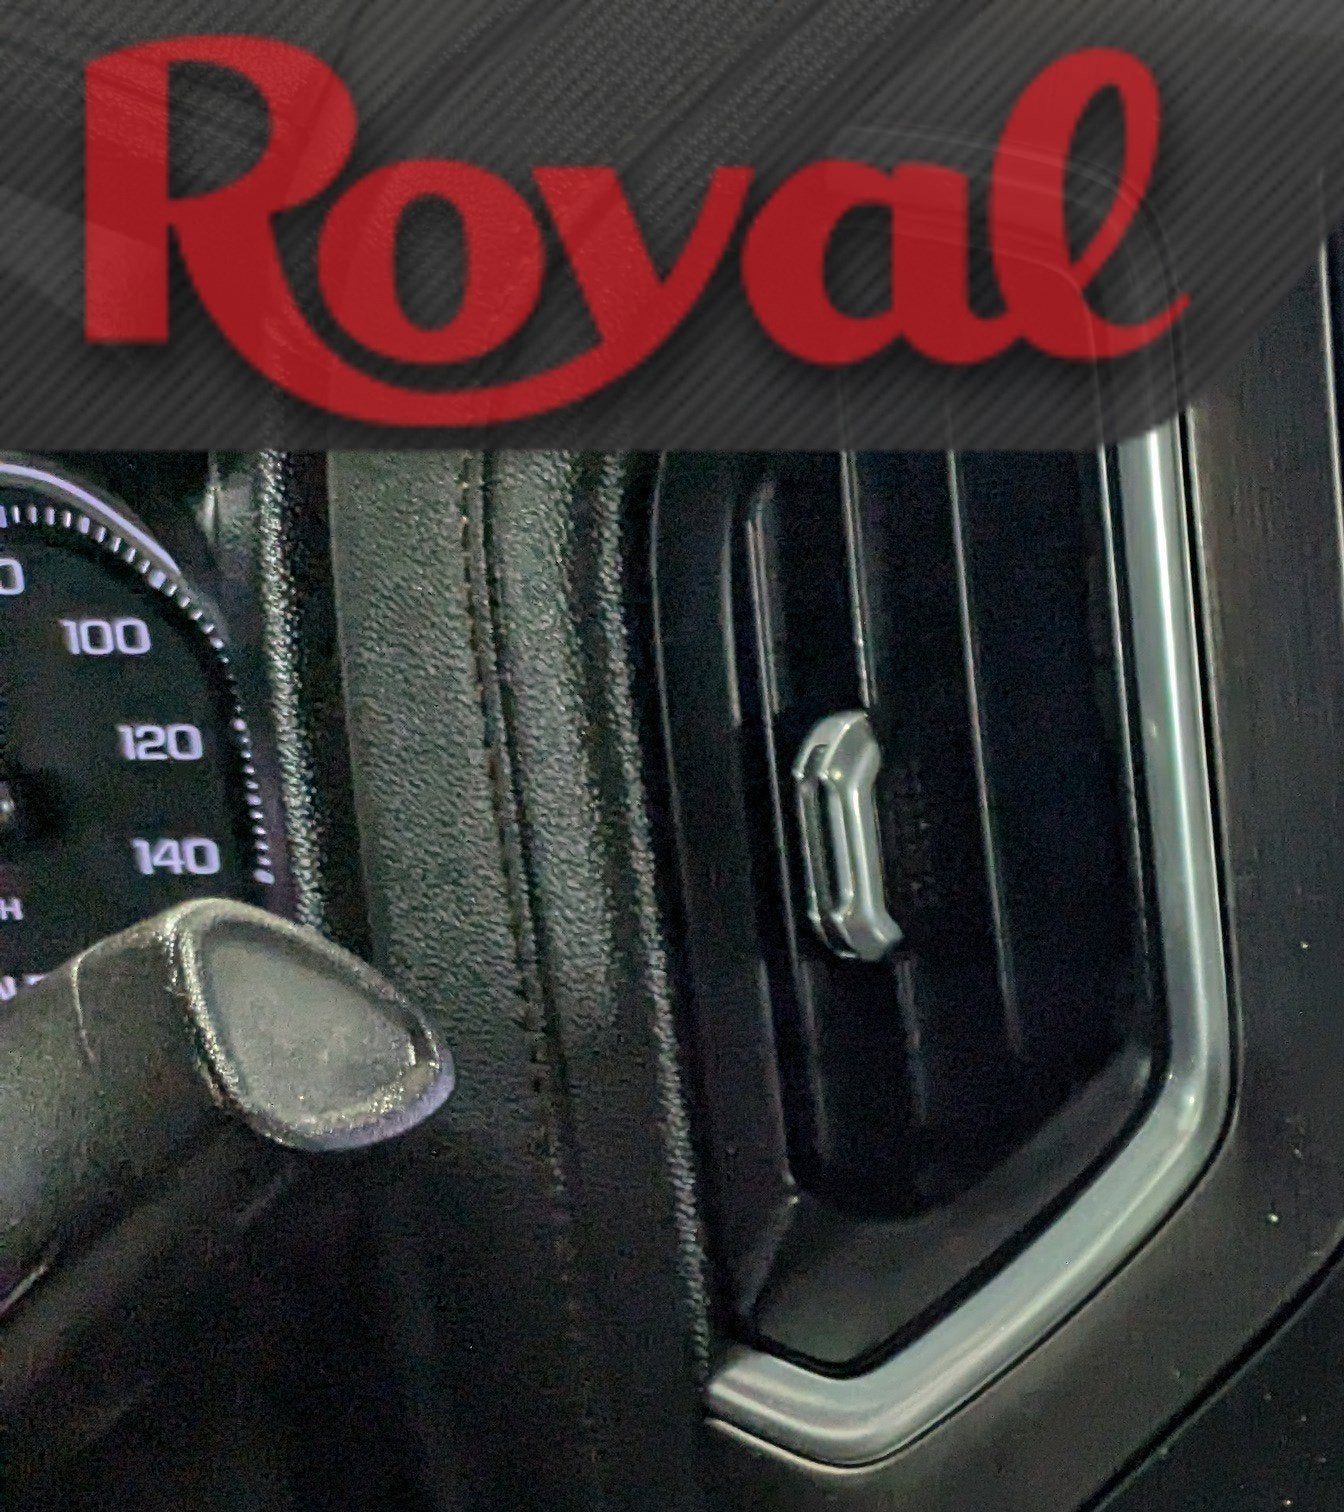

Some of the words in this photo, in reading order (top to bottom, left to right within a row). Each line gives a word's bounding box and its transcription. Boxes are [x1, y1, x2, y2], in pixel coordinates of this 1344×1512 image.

[60, 617, 152, 656] 100
[118, 723, 204, 761] 120
[133, 837, 221, 875] 140
